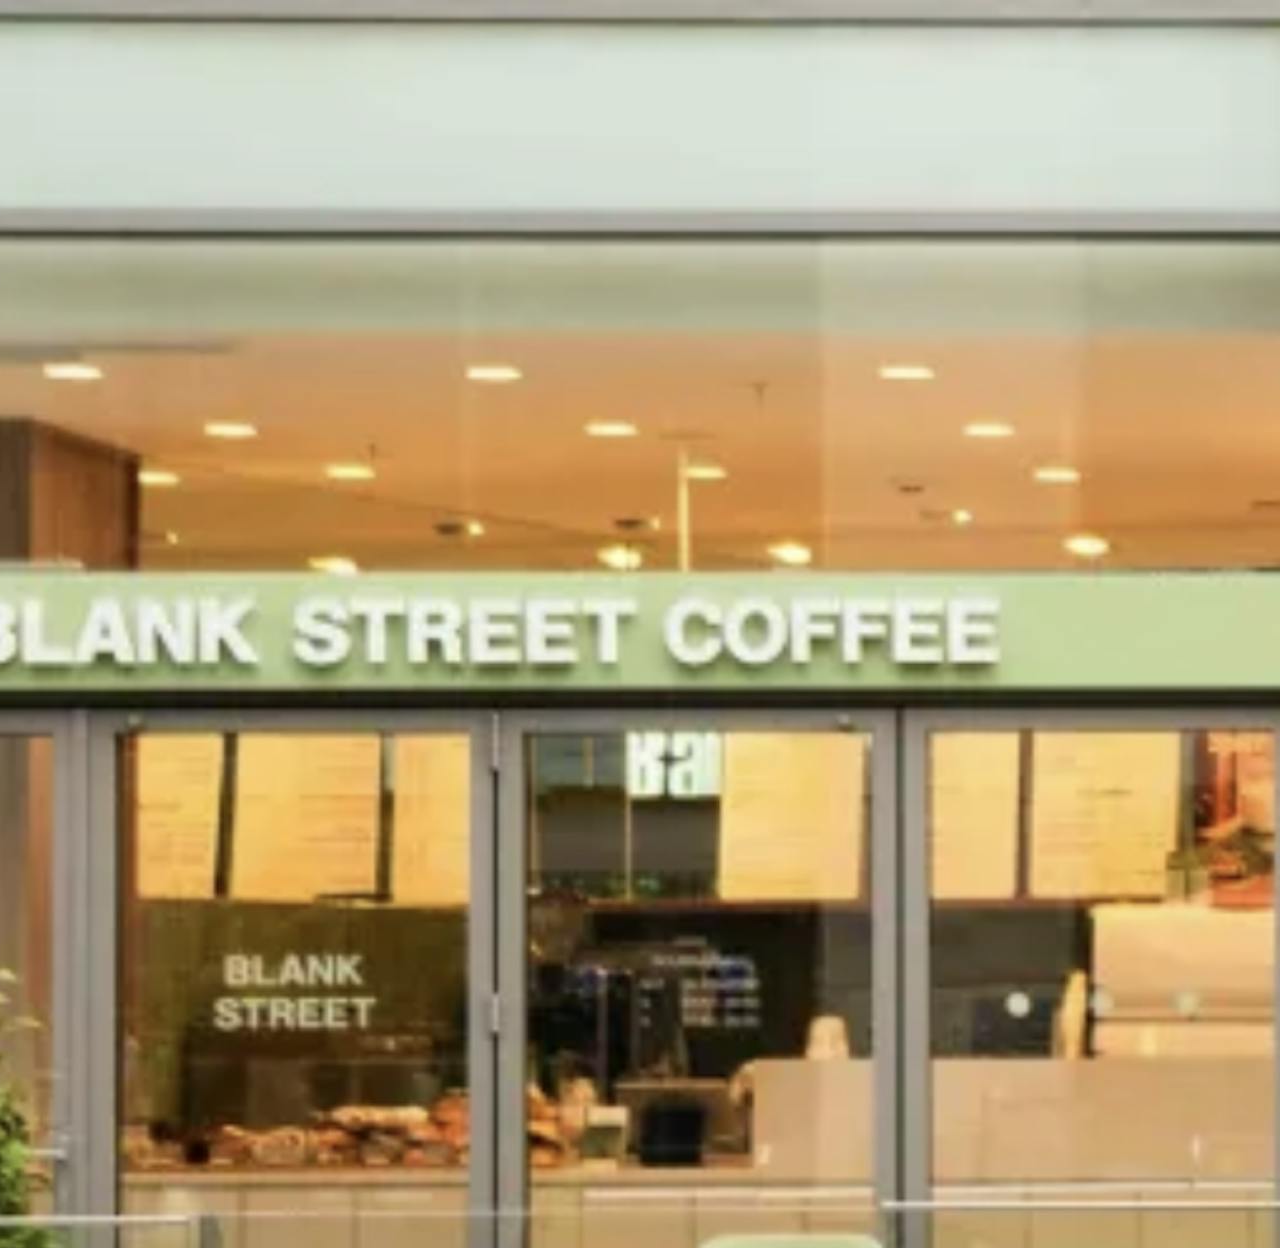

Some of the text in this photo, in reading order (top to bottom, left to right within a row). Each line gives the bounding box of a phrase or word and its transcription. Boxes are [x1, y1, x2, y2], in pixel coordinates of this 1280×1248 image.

[292, 598, 637, 666] STREET
[663, 598, 1001, 666] COFFEE
[223, 953, 363, 987] BLANK
[213, 997, 377, 1031] STREET
